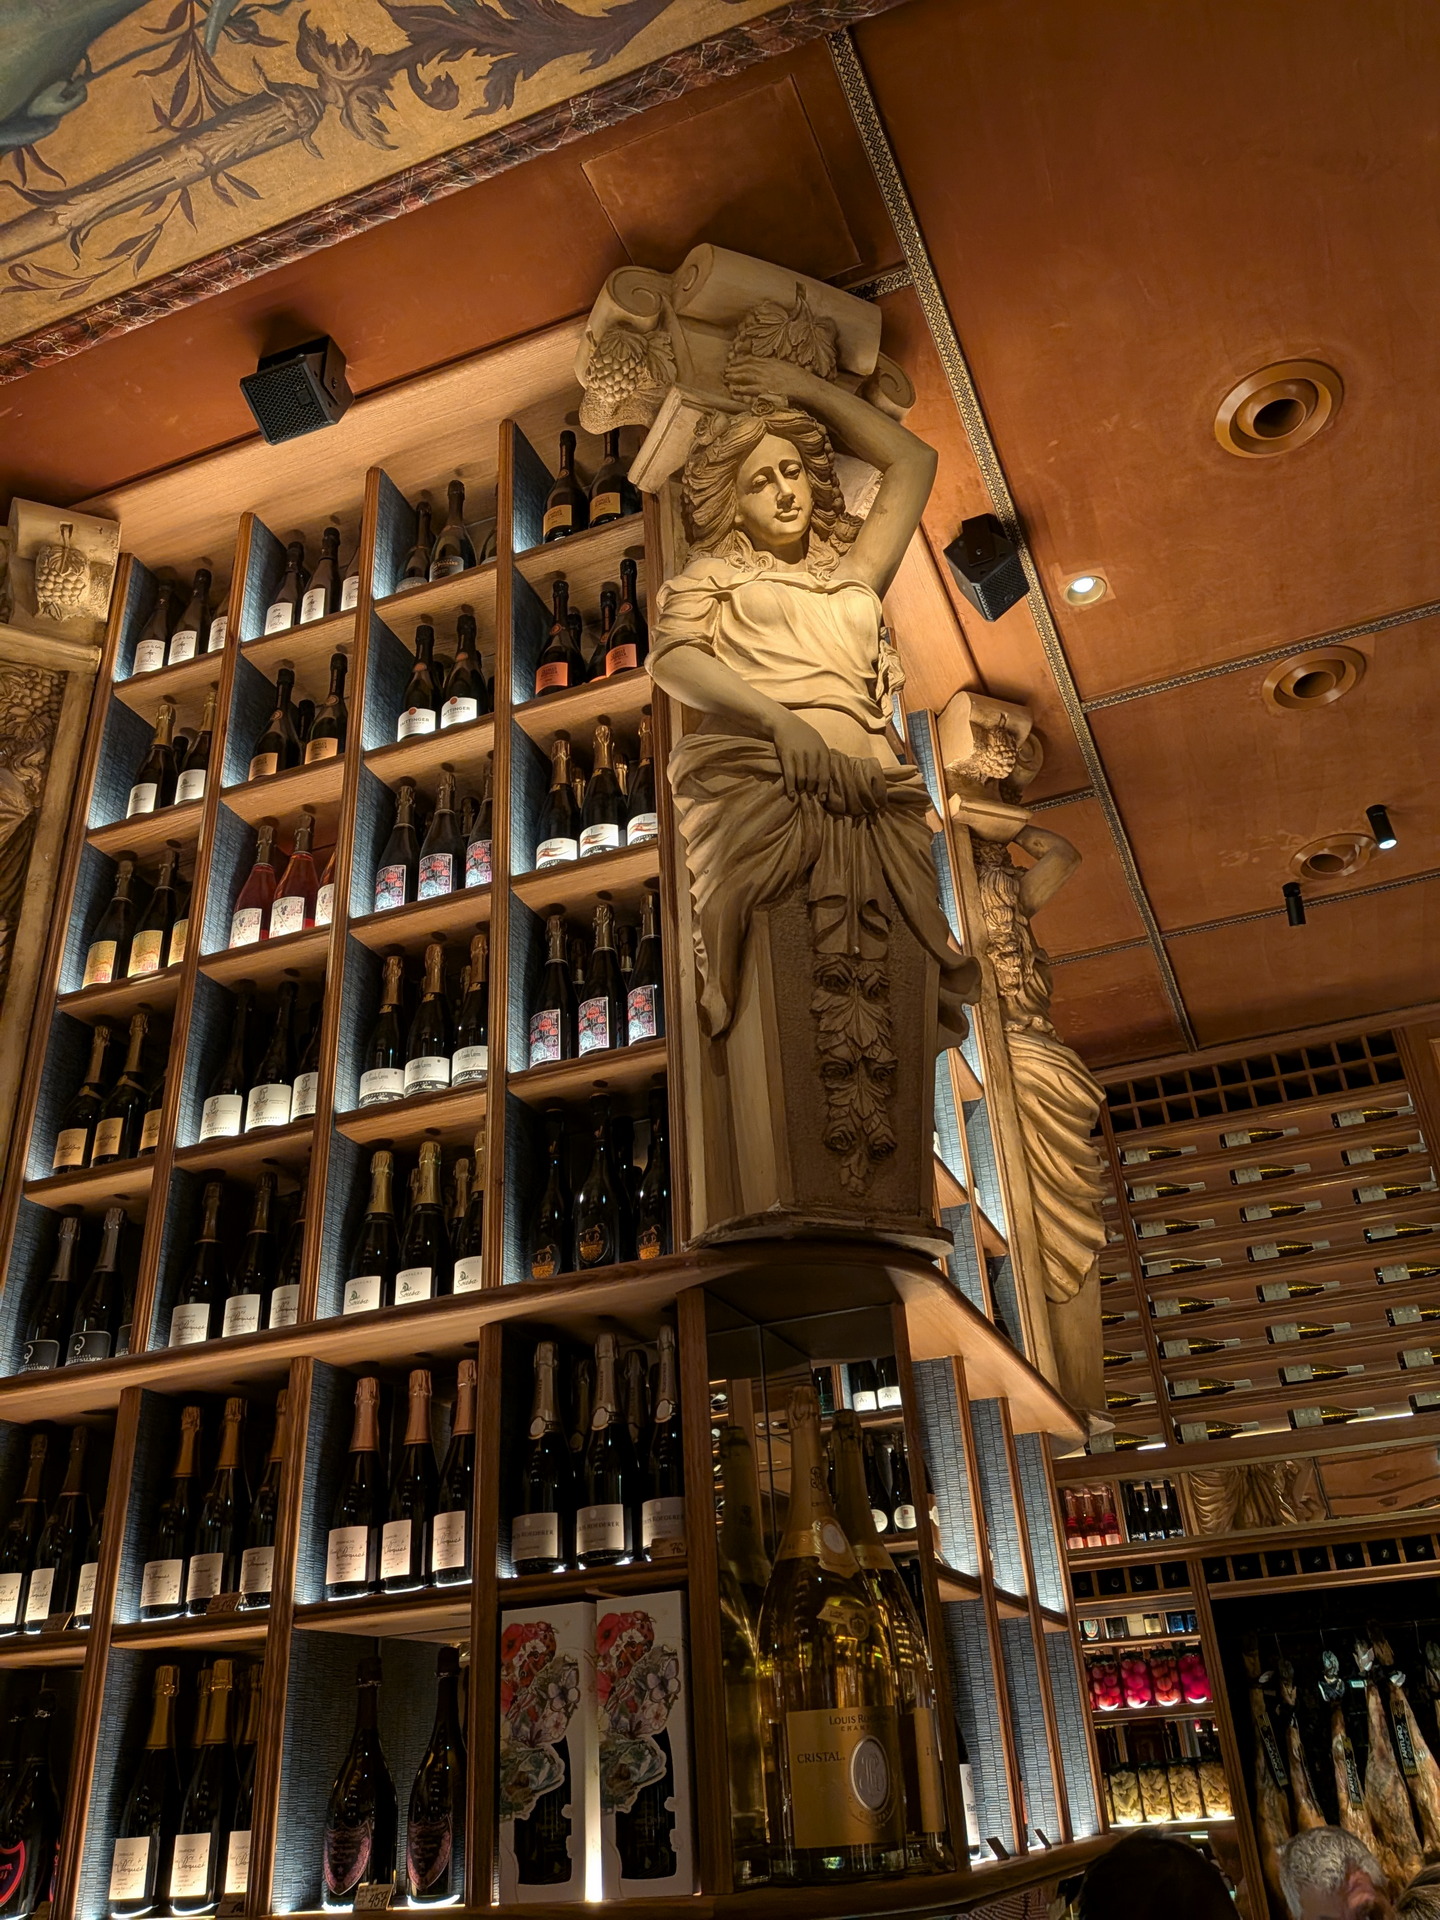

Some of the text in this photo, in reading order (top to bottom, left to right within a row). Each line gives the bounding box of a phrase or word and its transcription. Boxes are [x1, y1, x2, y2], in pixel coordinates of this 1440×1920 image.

[829, 1715, 856, 1726] LOUIS
[1396, 1724, 1408, 1759] ARTURO
[368, 1890, 389, 1908] 457
